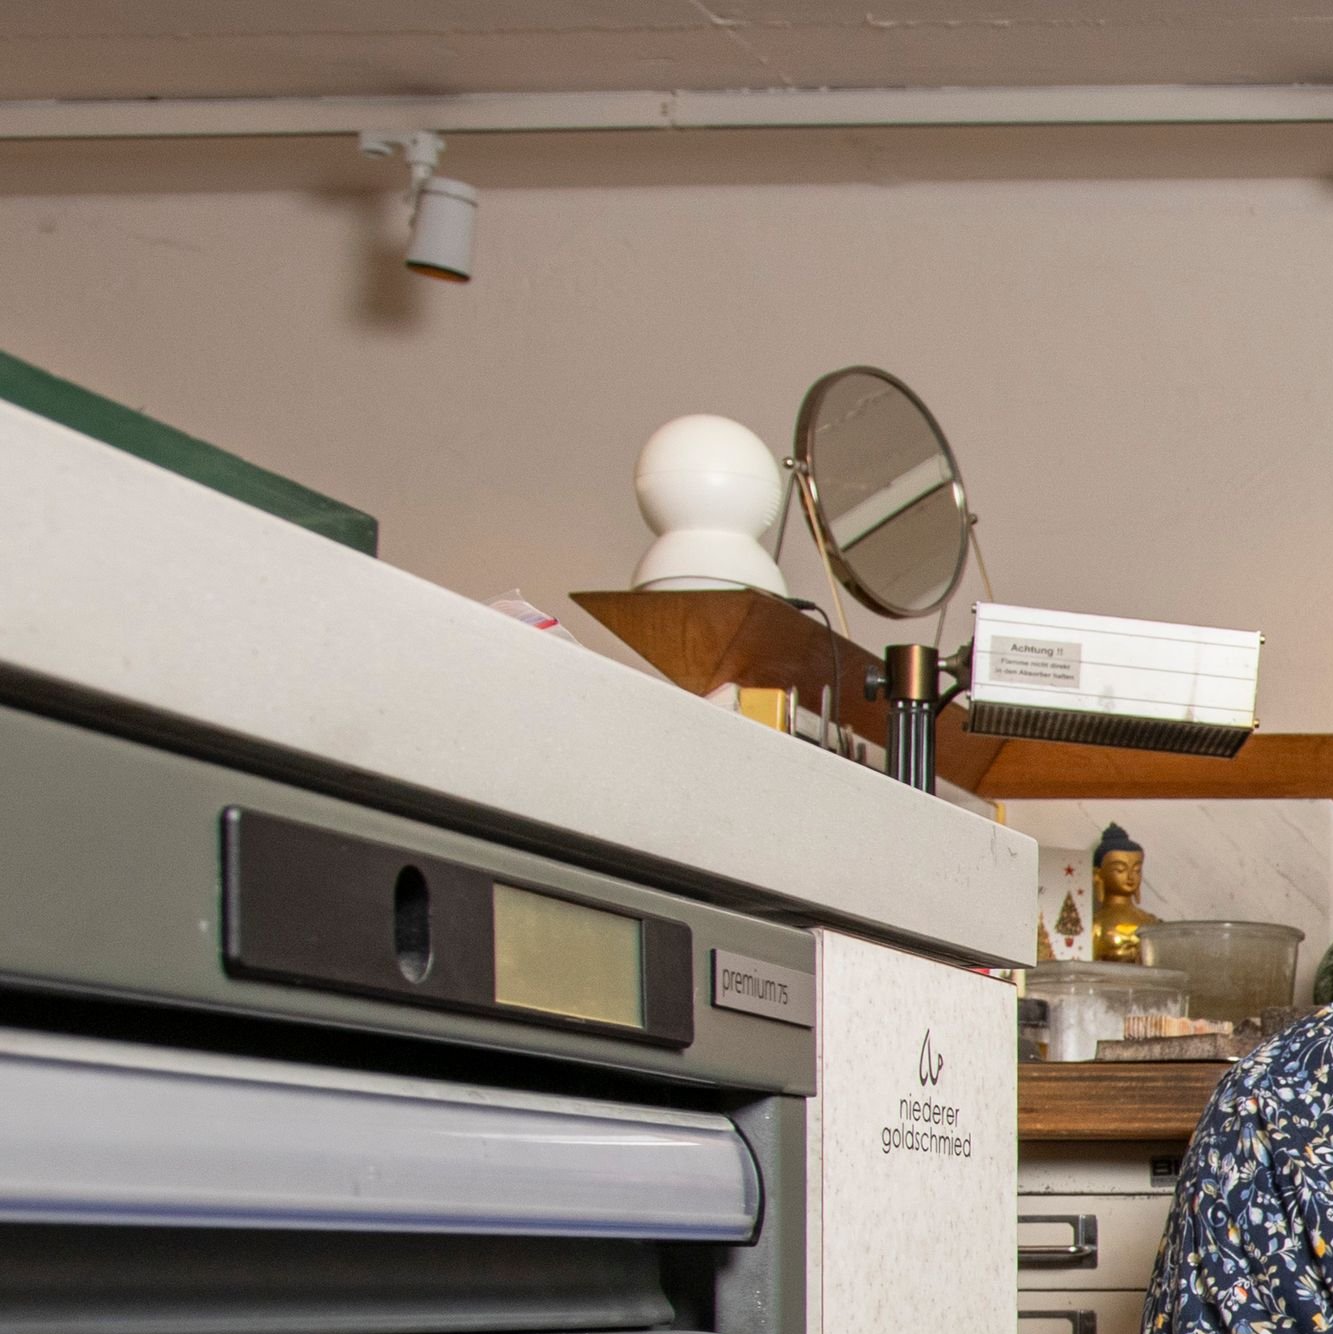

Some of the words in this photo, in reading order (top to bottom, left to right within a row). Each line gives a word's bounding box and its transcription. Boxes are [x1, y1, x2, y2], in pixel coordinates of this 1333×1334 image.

[1010, 643, 1054, 657] Achtung
[899, 1093, 960, 1127] niederer
[881, 1123, 972, 1158] goldschmied
